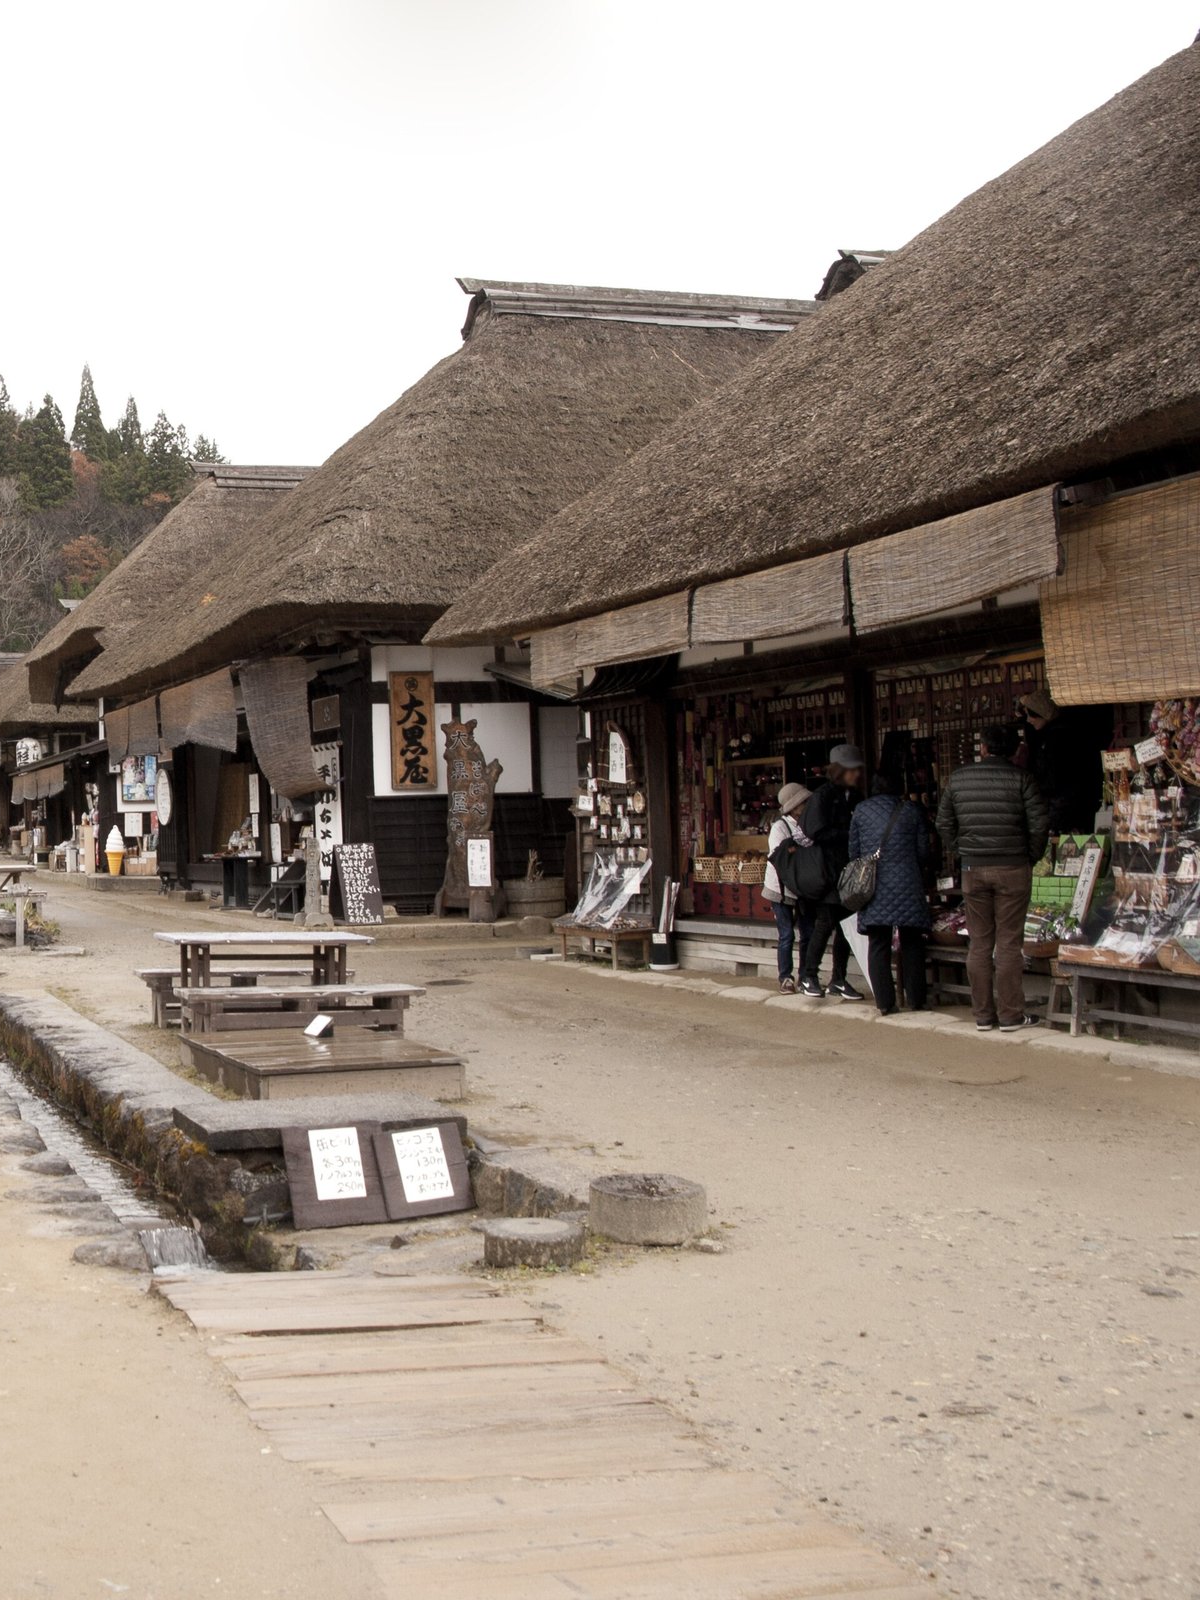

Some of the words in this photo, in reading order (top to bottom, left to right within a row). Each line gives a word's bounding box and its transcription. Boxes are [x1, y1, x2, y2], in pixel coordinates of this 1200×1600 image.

[397, 692, 428, 784] 大黒屋
[449, 729, 471, 814] 大黒屋
[346, 893, 365, 901] うどん
